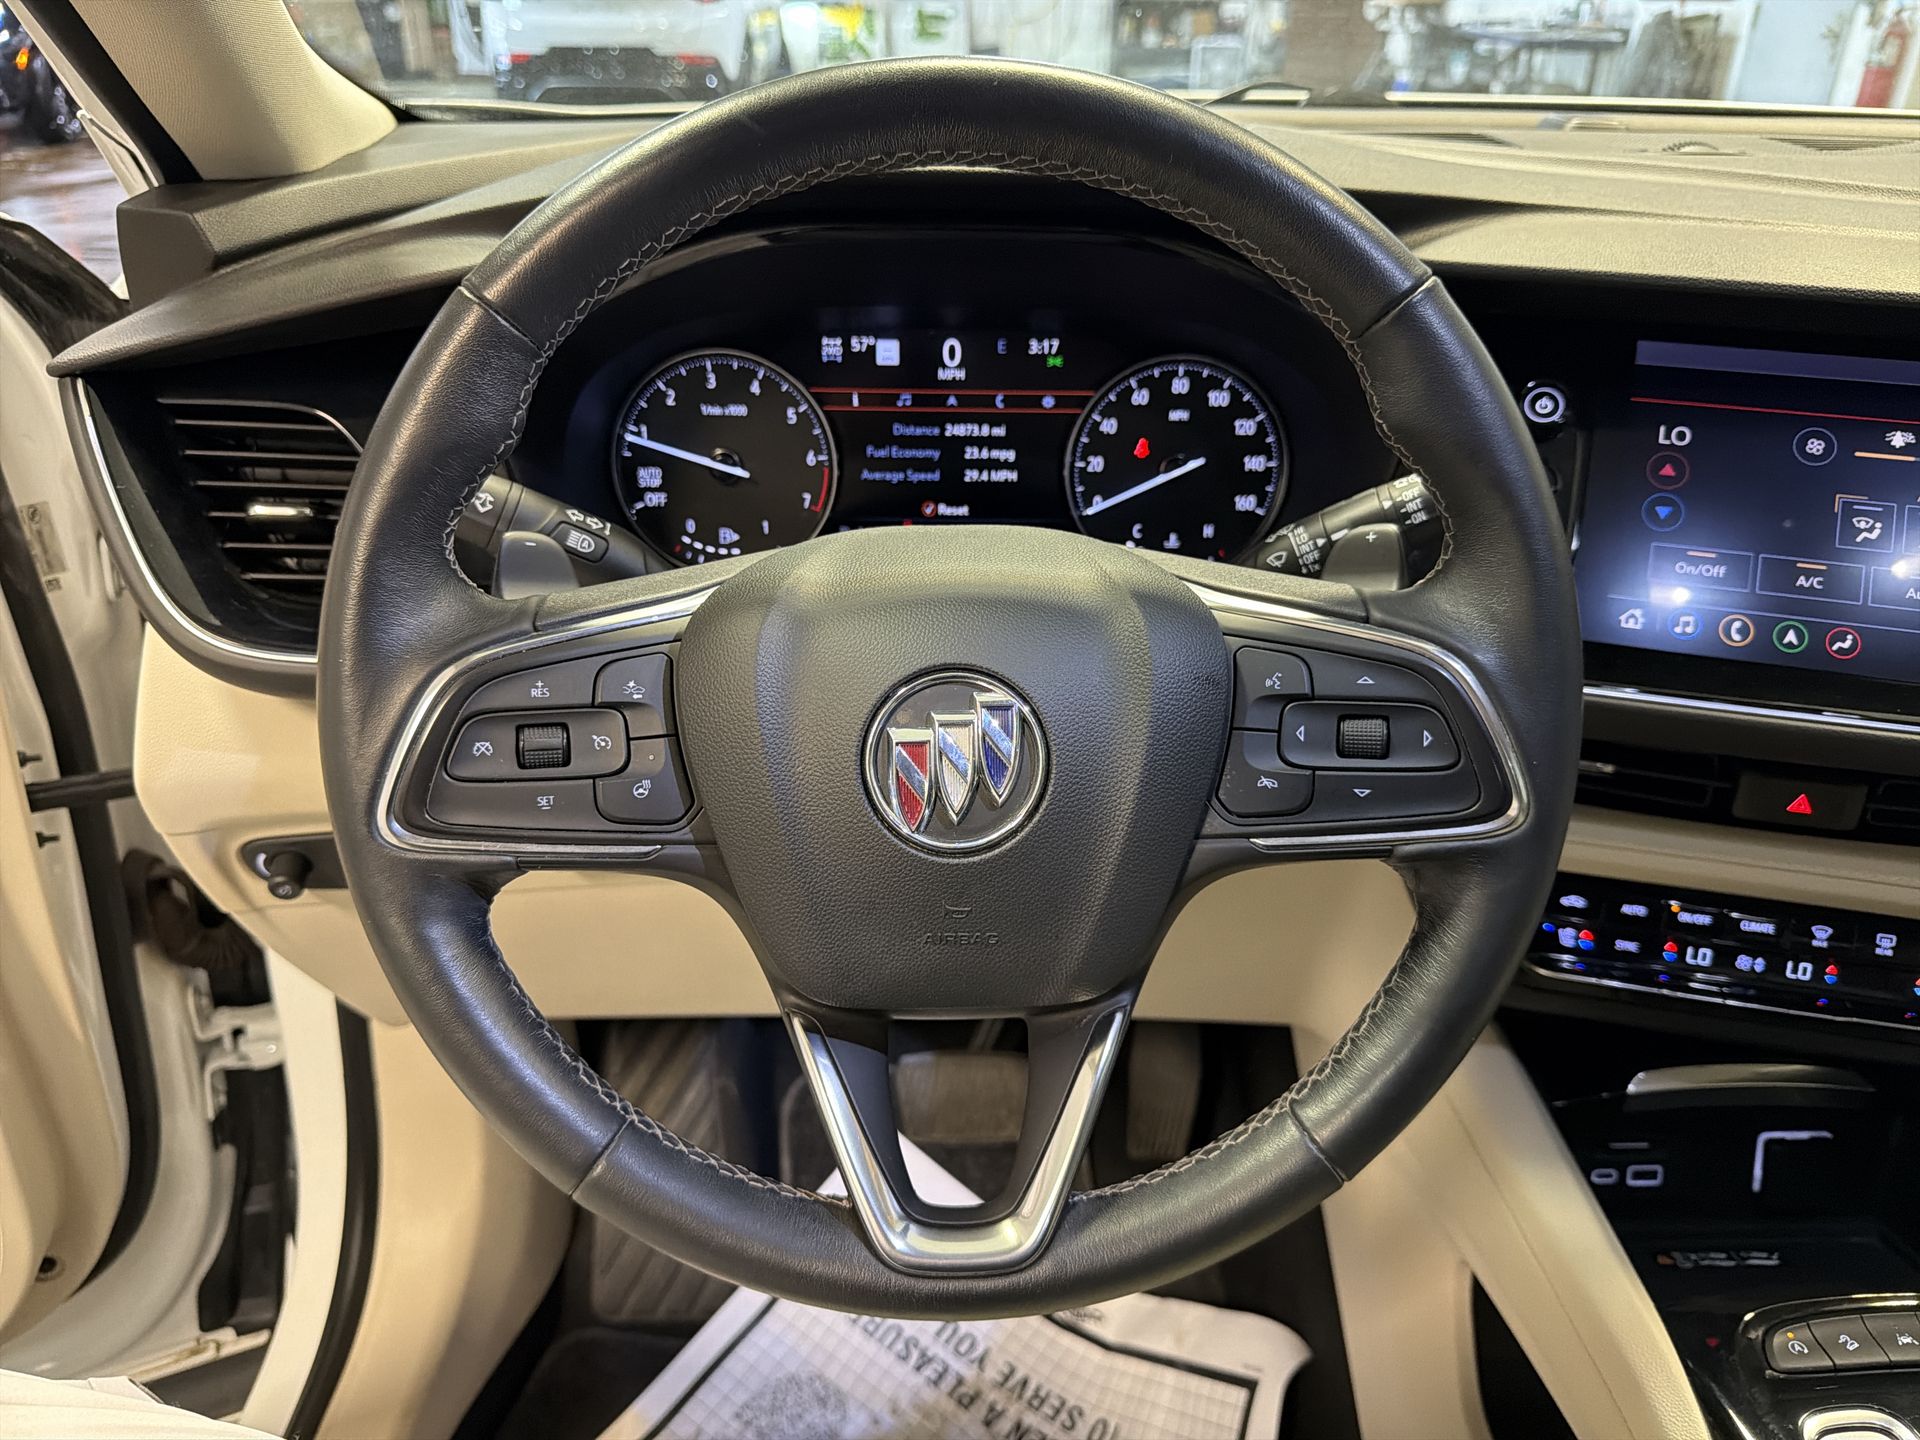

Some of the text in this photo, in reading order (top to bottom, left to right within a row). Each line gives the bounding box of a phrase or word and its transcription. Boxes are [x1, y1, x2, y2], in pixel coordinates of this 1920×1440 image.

[942, 337, 962, 367] 0
[1028, 338, 1060, 355] 3:17
[705, 372, 716, 389] 3
[937, 368, 966, 381] MPH
[750, 379, 761, 396] 4
[1171, 376, 1191, 395] 80
[665, 388, 676, 406] 2
[1131, 387, 1150, 406] 60
[1207, 389, 1231, 407] 100
[786, 406, 797, 424] 5
[1168, 408, 1190, 421] MPH
[892, 422, 940, 437] Distance
[991, 424, 1006, 437] mi
[1100, 417, 1118, 435] 40
[1234, 418, 1257, 436] 120
[1658, 425, 1692, 447] LO
[806, 449, 816, 467] 6
[866, 445, 1016, 462] Fuel Economy 23.6 mpg
[1086, 455, 1105, 473] 20
[1243, 454, 1267, 473] 140
[638, 466, 662, 479] AUTO
[861, 468, 1018, 484] Average Speed 29.4 MPH
[638, 478, 662, 488] STOP
[644, 492, 668, 507] OFF
[801, 491, 812, 510] 7
[1402, 486, 1420, 501] OFF
[937, 502, 970, 517] Reset
[1234, 494, 1258, 512] 160
[1405, 498, 1425, 514] INT
[1410, 510, 1427, 525] ON
[1132, 523, 1144, 540] C
[1203, 523, 1216, 540] H
[1295, 533, 1309, 545] LO
[1299, 540, 1316, 555] INT
[1302, 551, 1321, 565] OFF
[1674, 561, 1728, 579] On/Off
[1796, 575, 1824, 590] A/C
[531, 688, 550, 698] RES
[537, 796, 554, 806] SET
[1740, 919, 1777, 935] CLIMATE
[923, 932, 999, 945] AIRBAG
[1685, 945, 1714, 968] LO
[1785, 960, 1813, 982] LO
[934, 1319, 992, 1374] YOU
[846, 1316, 1006, 1428] A PLEASUR
[992, 1360, 1085, 1432] SERVE
